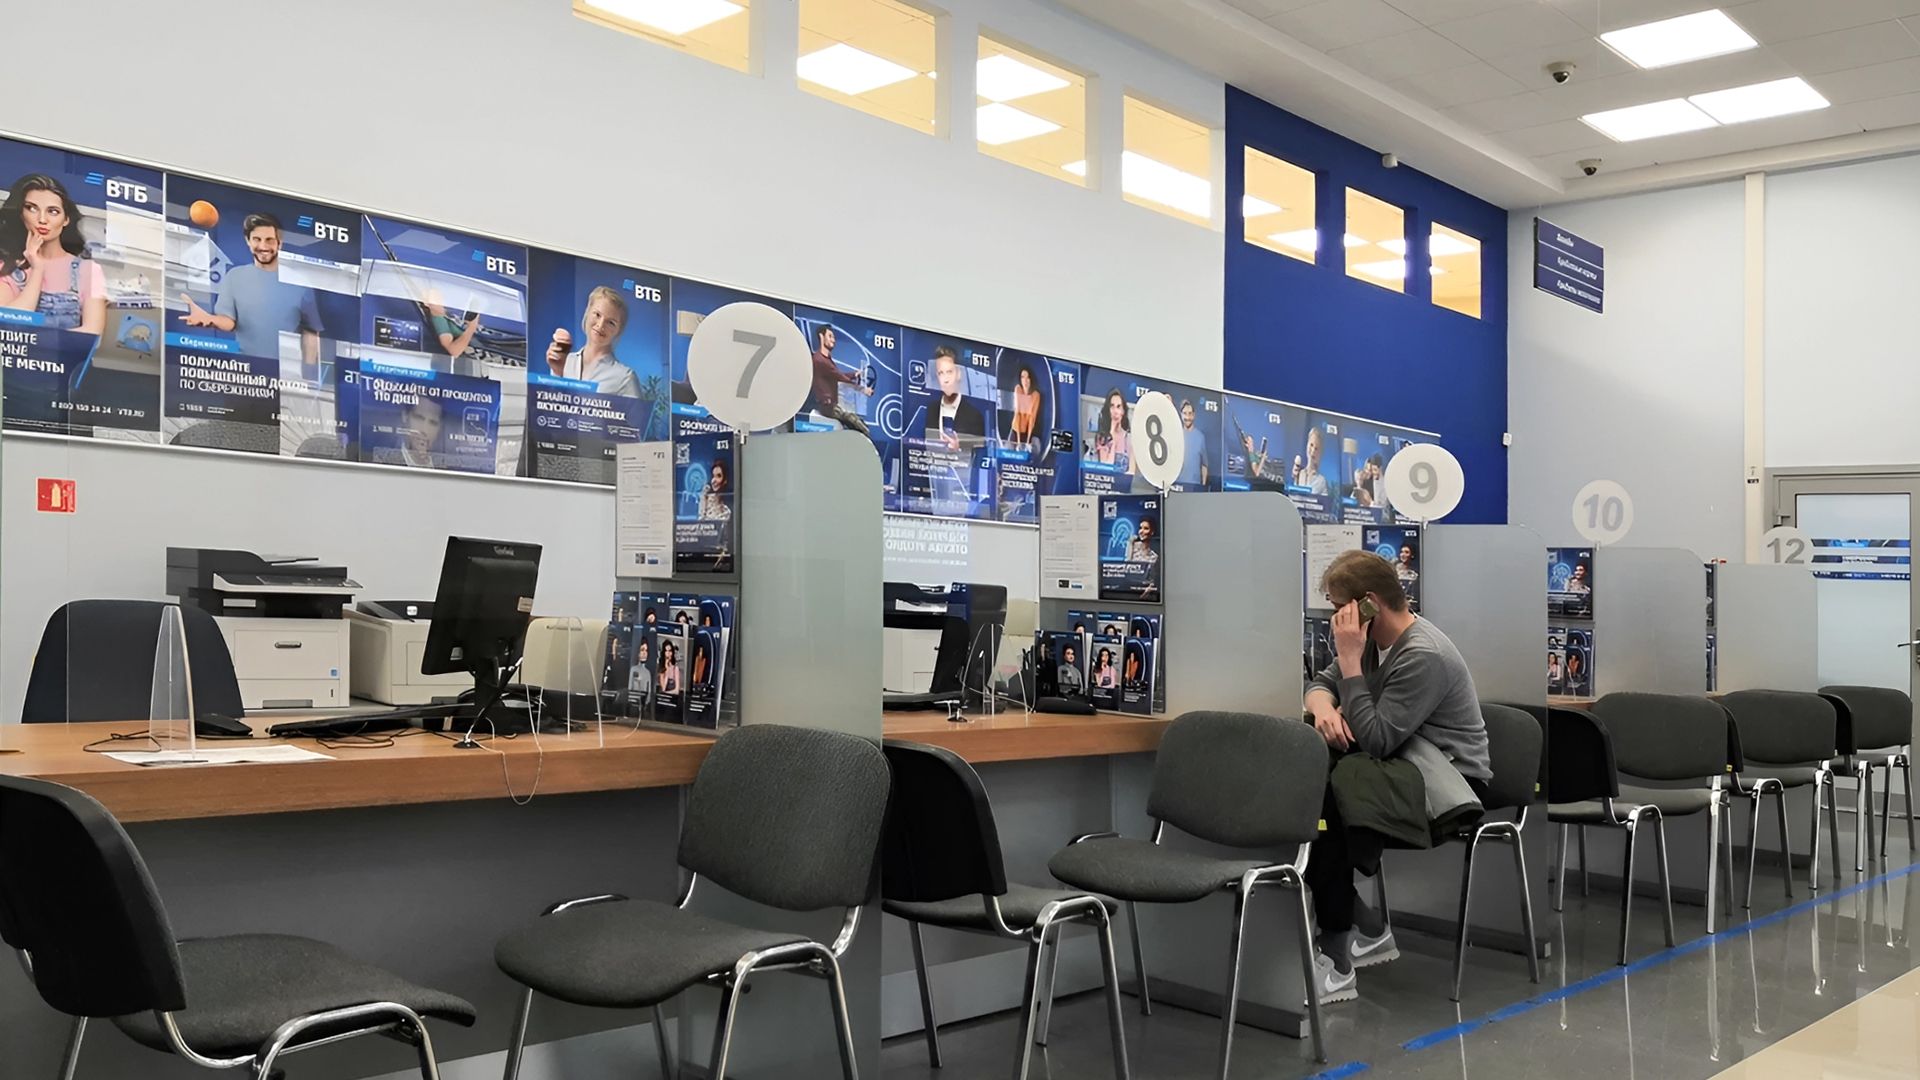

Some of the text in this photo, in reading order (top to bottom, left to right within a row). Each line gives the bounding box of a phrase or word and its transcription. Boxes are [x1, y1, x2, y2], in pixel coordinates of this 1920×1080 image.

[106, 179, 148, 203] ВТБ
[314, 220, 349, 243] ВТБ
[486, 256, 516, 276] ВТБ
[634, 284, 661, 303] ВТБ
[874, 334, 895, 350] ВТБ
[17, 358, 65, 374] МЕЧТЫ
[180, 354, 251, 374] ПОЛУЧАЙТЕ
[733, 329, 776, 399] 7
[972, 354, 990, 368] ВТБ
[180, 367, 309, 393] ПОВЫШЕННЫЙ ДОХОД
[180, 379, 195, 390] ПО
[429, 387, 440, 397] ОТ
[573, 396, 580, 405] О
[1146, 414, 1168, 466] 8
[1409, 461, 1438, 504] 9
[1583, 493, 1624, 531] 10
[1767, 538, 1805, 564] 12
